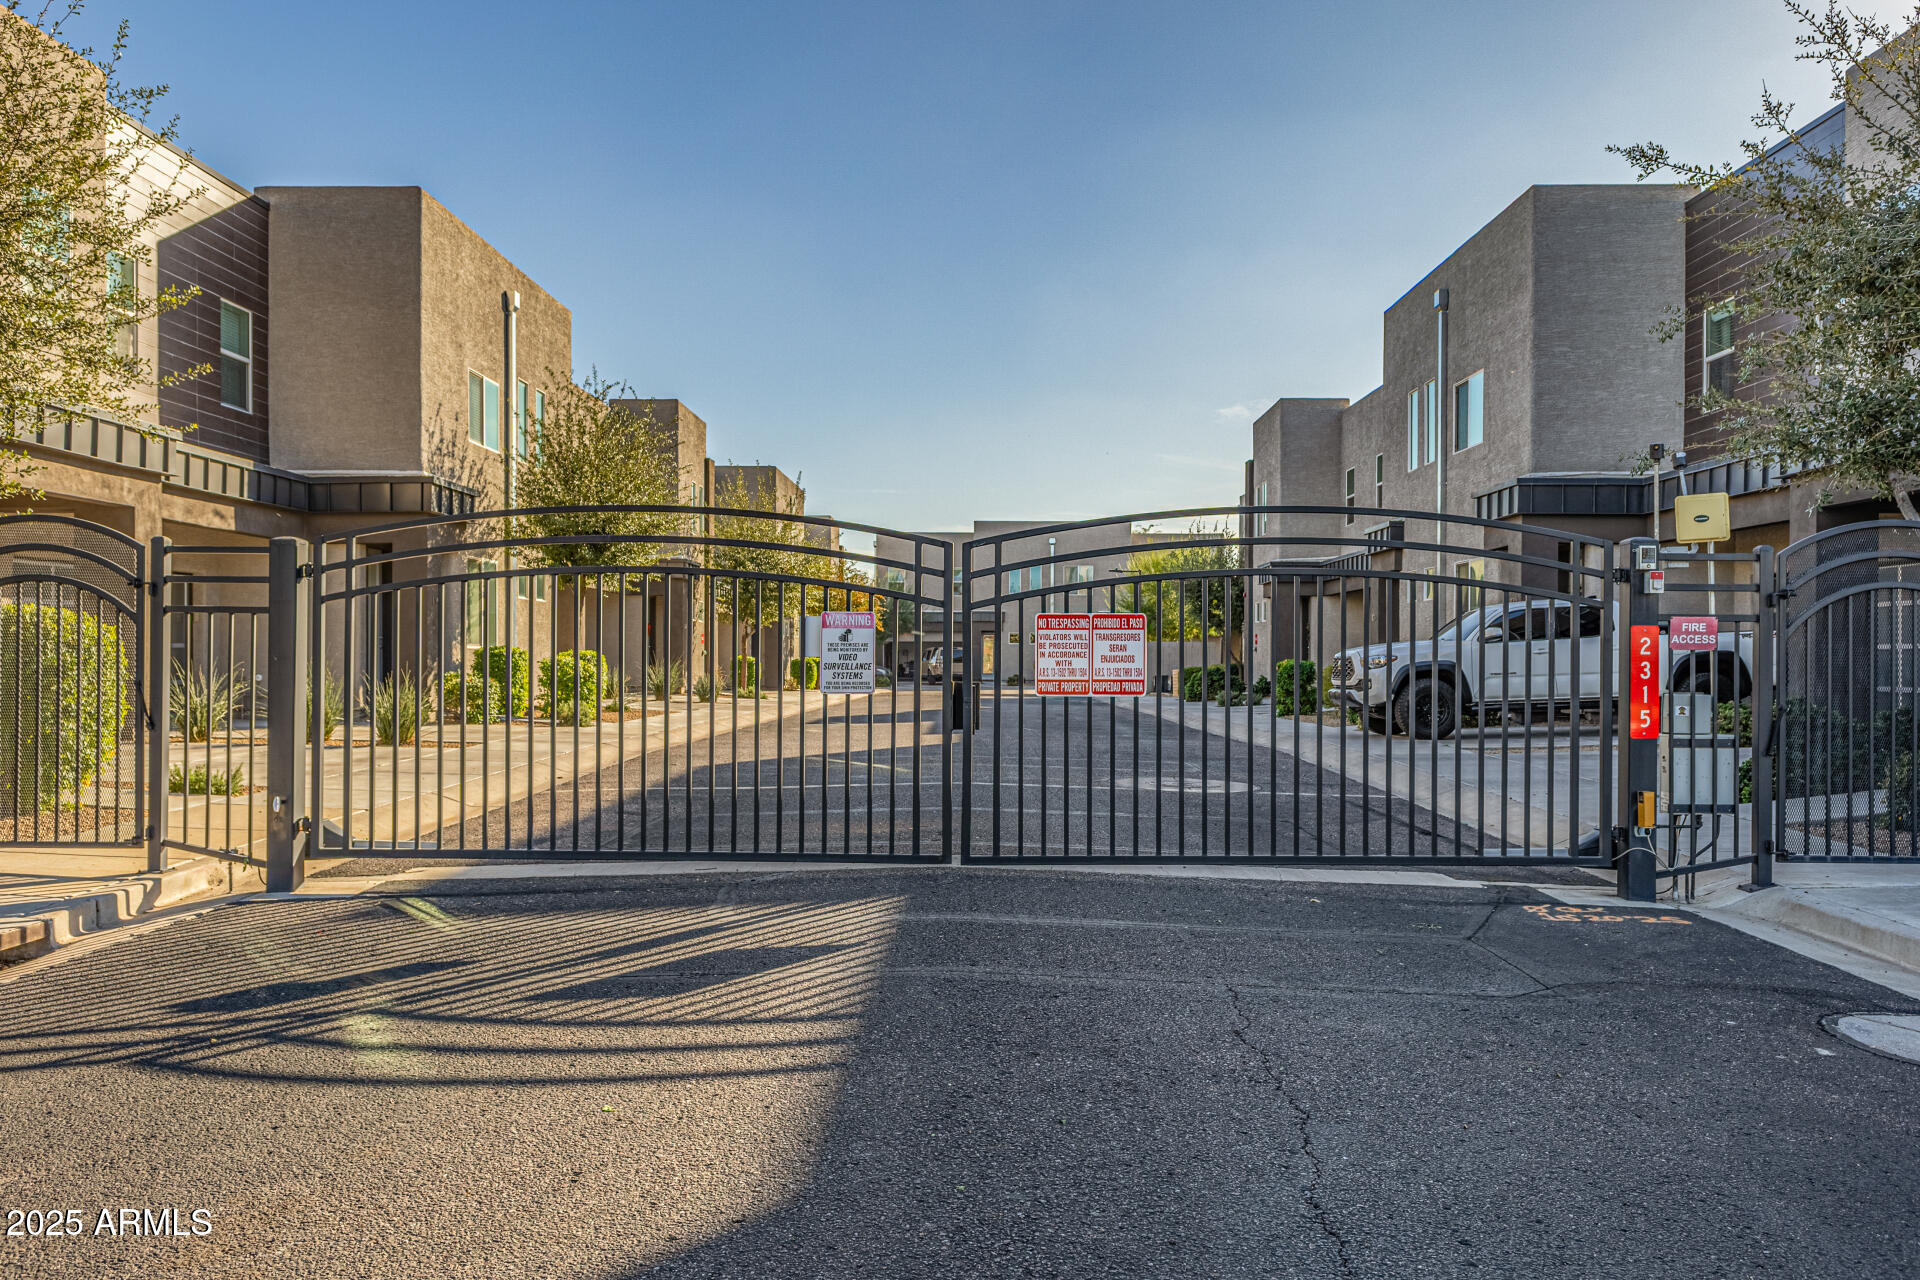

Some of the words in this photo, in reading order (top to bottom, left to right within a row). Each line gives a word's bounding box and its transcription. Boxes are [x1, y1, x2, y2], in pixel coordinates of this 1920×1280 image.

[825, 614, 871, 626] WARNING
[1038, 618, 1046, 629] NO
[1048, 618, 1089, 629] TRESPASSING
[1093, 618, 1120, 629] PROHIBIDO
[1121, 618, 1128, 629] EL
[1129, 618, 1143, 629] PASO
[1681, 622, 1706, 632] FIRE
[1039, 633, 1071, 641] VIOLATORS
[1073, 633, 1088, 641] WILL
[1095, 633, 1141, 641] TRANSGRESORES
[1671, 634, 1716, 644] ACCESS
[1108, 644, 1127, 652] SERAN
[838, 653, 858, 661] VIDEO
[1040, 651, 1046, 659] IN
[1047, 651, 1087, 659] ACCORDANCE
[1100, 655, 1136, 663] ENJUICIADOS
[823, 663, 872, 671] SURVEILLANCE
[832, 672, 864, 680] SYSTEMS
[1038, 682, 1060, 692] PRIVATE
[1061, 682, 1089, 692] PROPERTY
[1092, 682, 1120, 692] PROPIEDAD
[1121, 682, 1144, 692] PRIVADA
[1640, 637, 1651, 728] 2315
